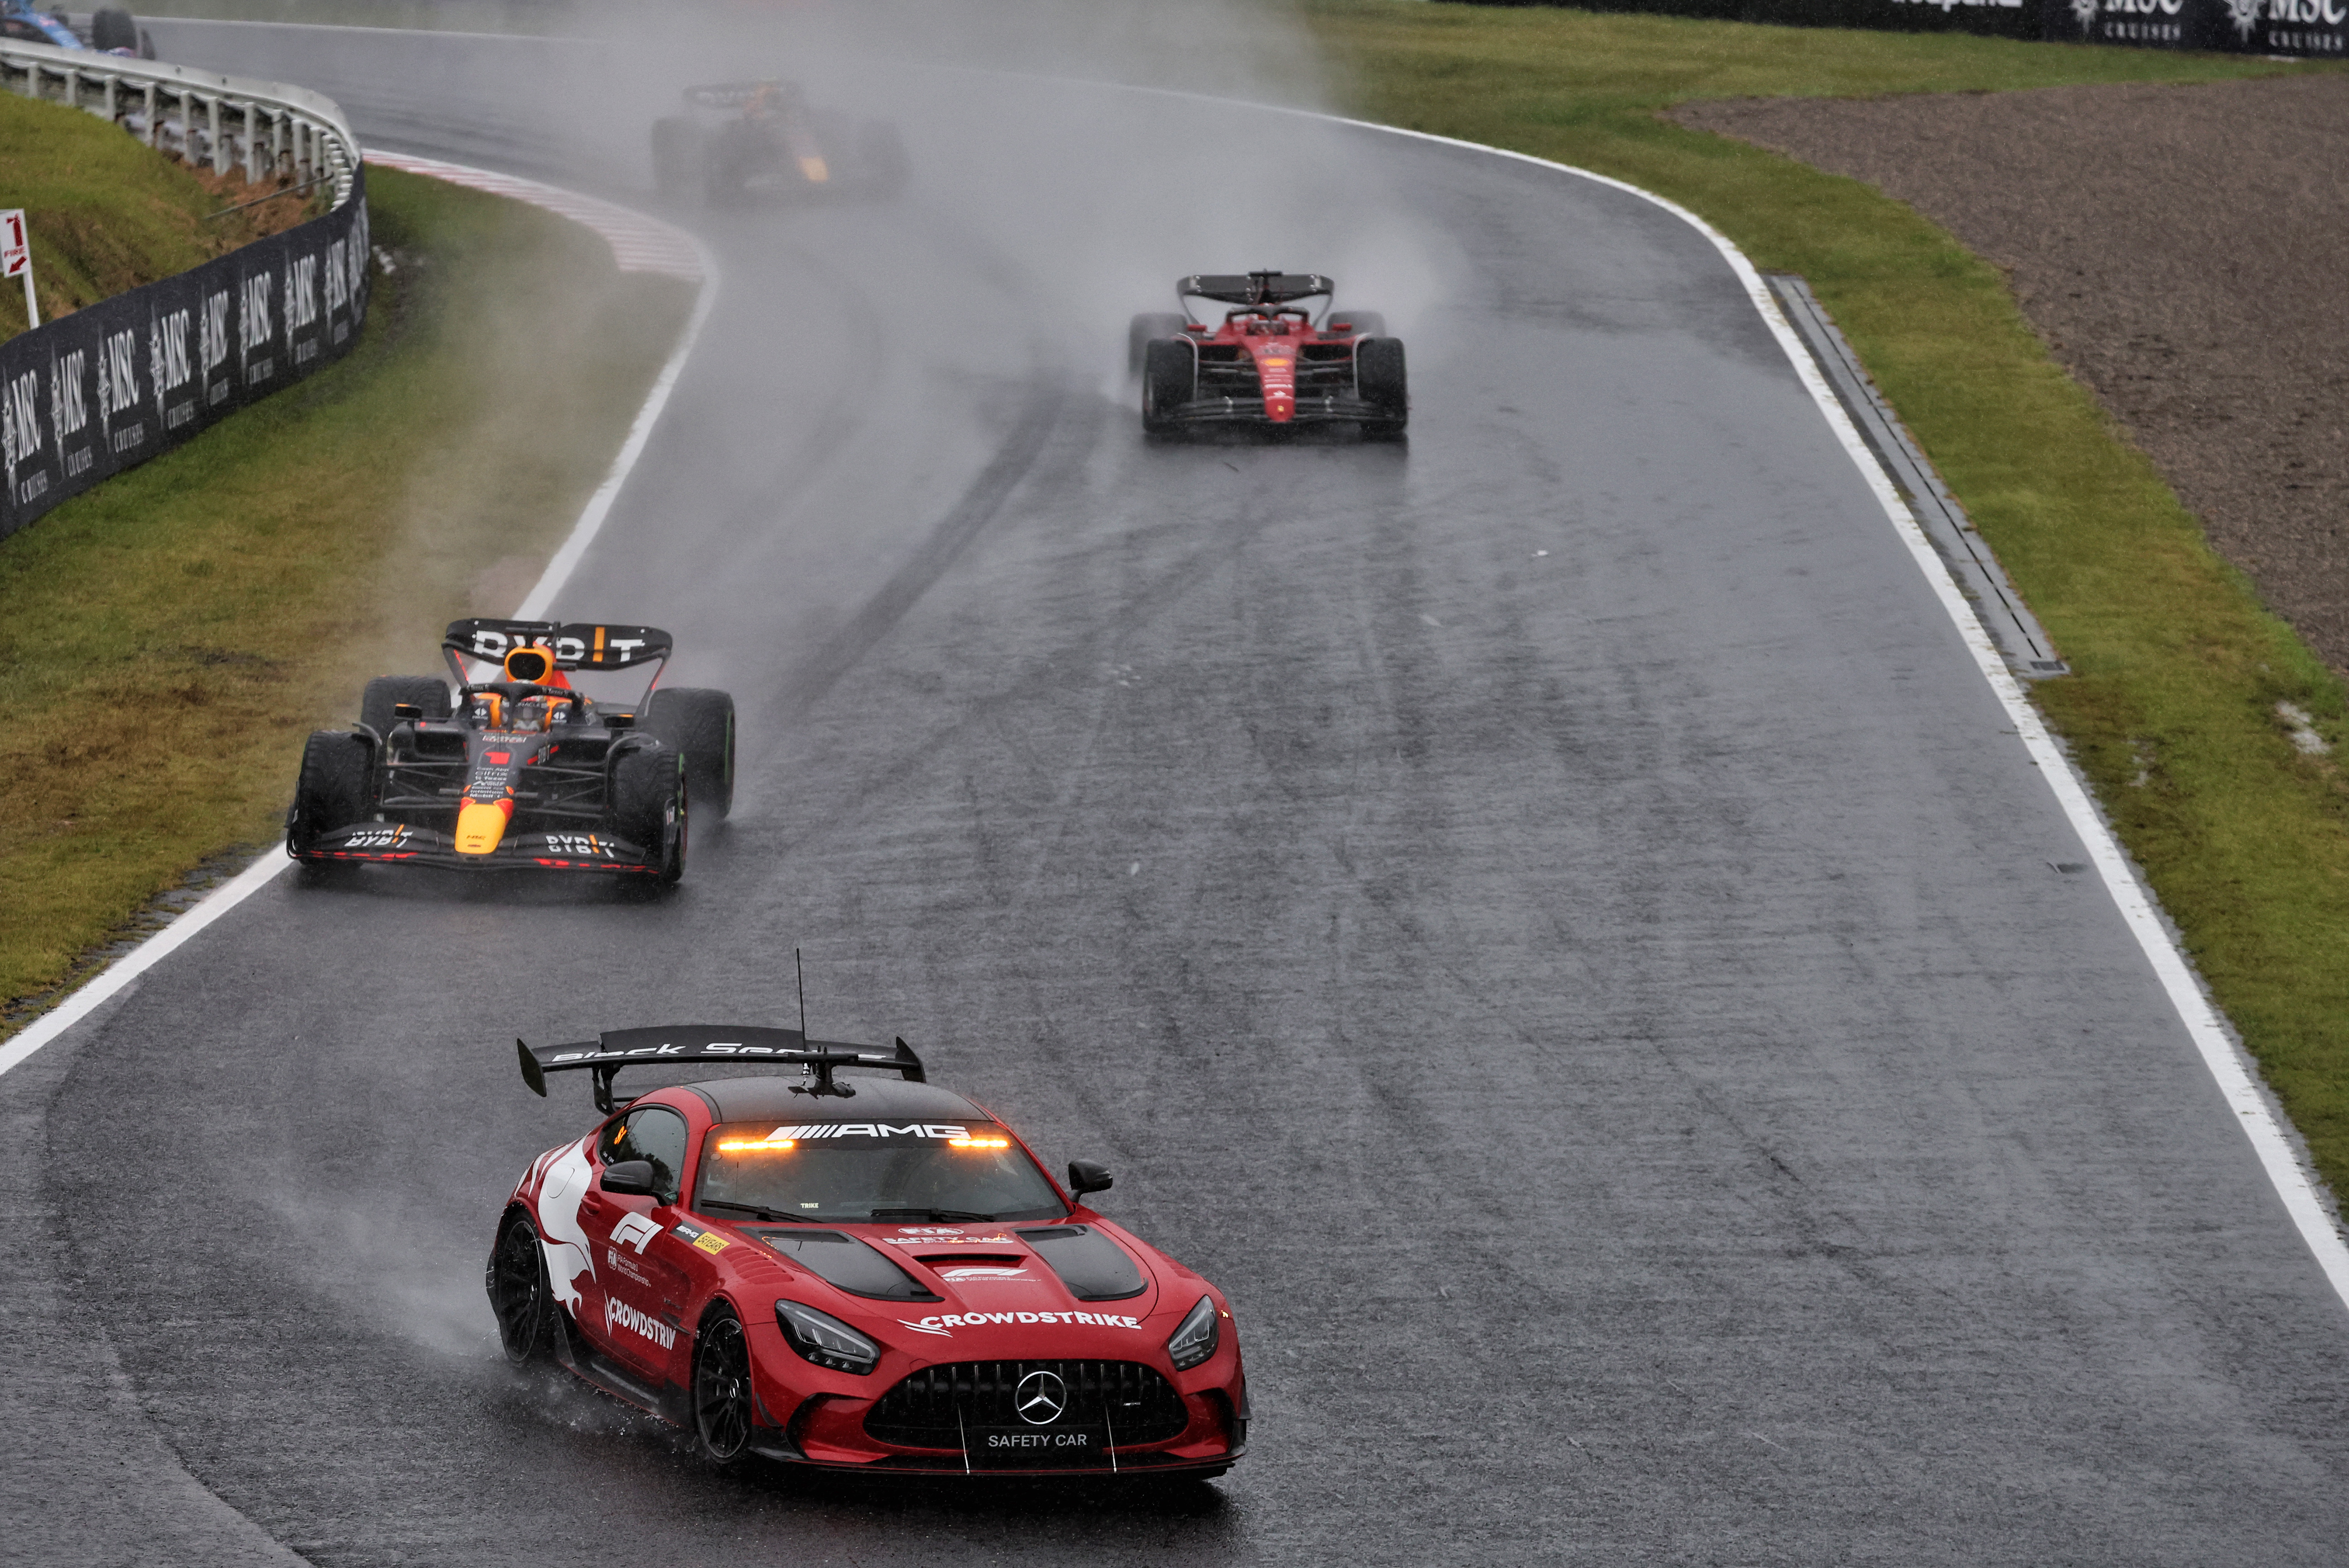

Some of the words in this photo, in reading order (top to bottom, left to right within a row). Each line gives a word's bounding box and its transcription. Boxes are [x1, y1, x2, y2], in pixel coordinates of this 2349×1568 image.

[4, 247, 25, 258] FIRE
[161, 308, 191, 391] MSC
[107, 328, 139, 413] MSC
[60, 348, 87, 435] MSC
[11, 369, 42, 461] MSC
[484, 752, 510, 764] 1
[551, 1043, 686, 1062] Black
[831, 1124, 972, 1140] AMG
[609, 1211, 664, 1255] F1
[682, 1228, 699, 1238] AMG
[608, 1250, 617, 1267] FIA
[623, 1257, 636, 1271] Formula
[617, 1263, 627, 1275] World
[627, 1268, 649, 1287] Championship
[920, 1311, 1143, 1330] CROWDSTRIKE
[988, 1435, 1051, 1447] SAFETY
[1055, 1434, 1087, 1446] CAR
